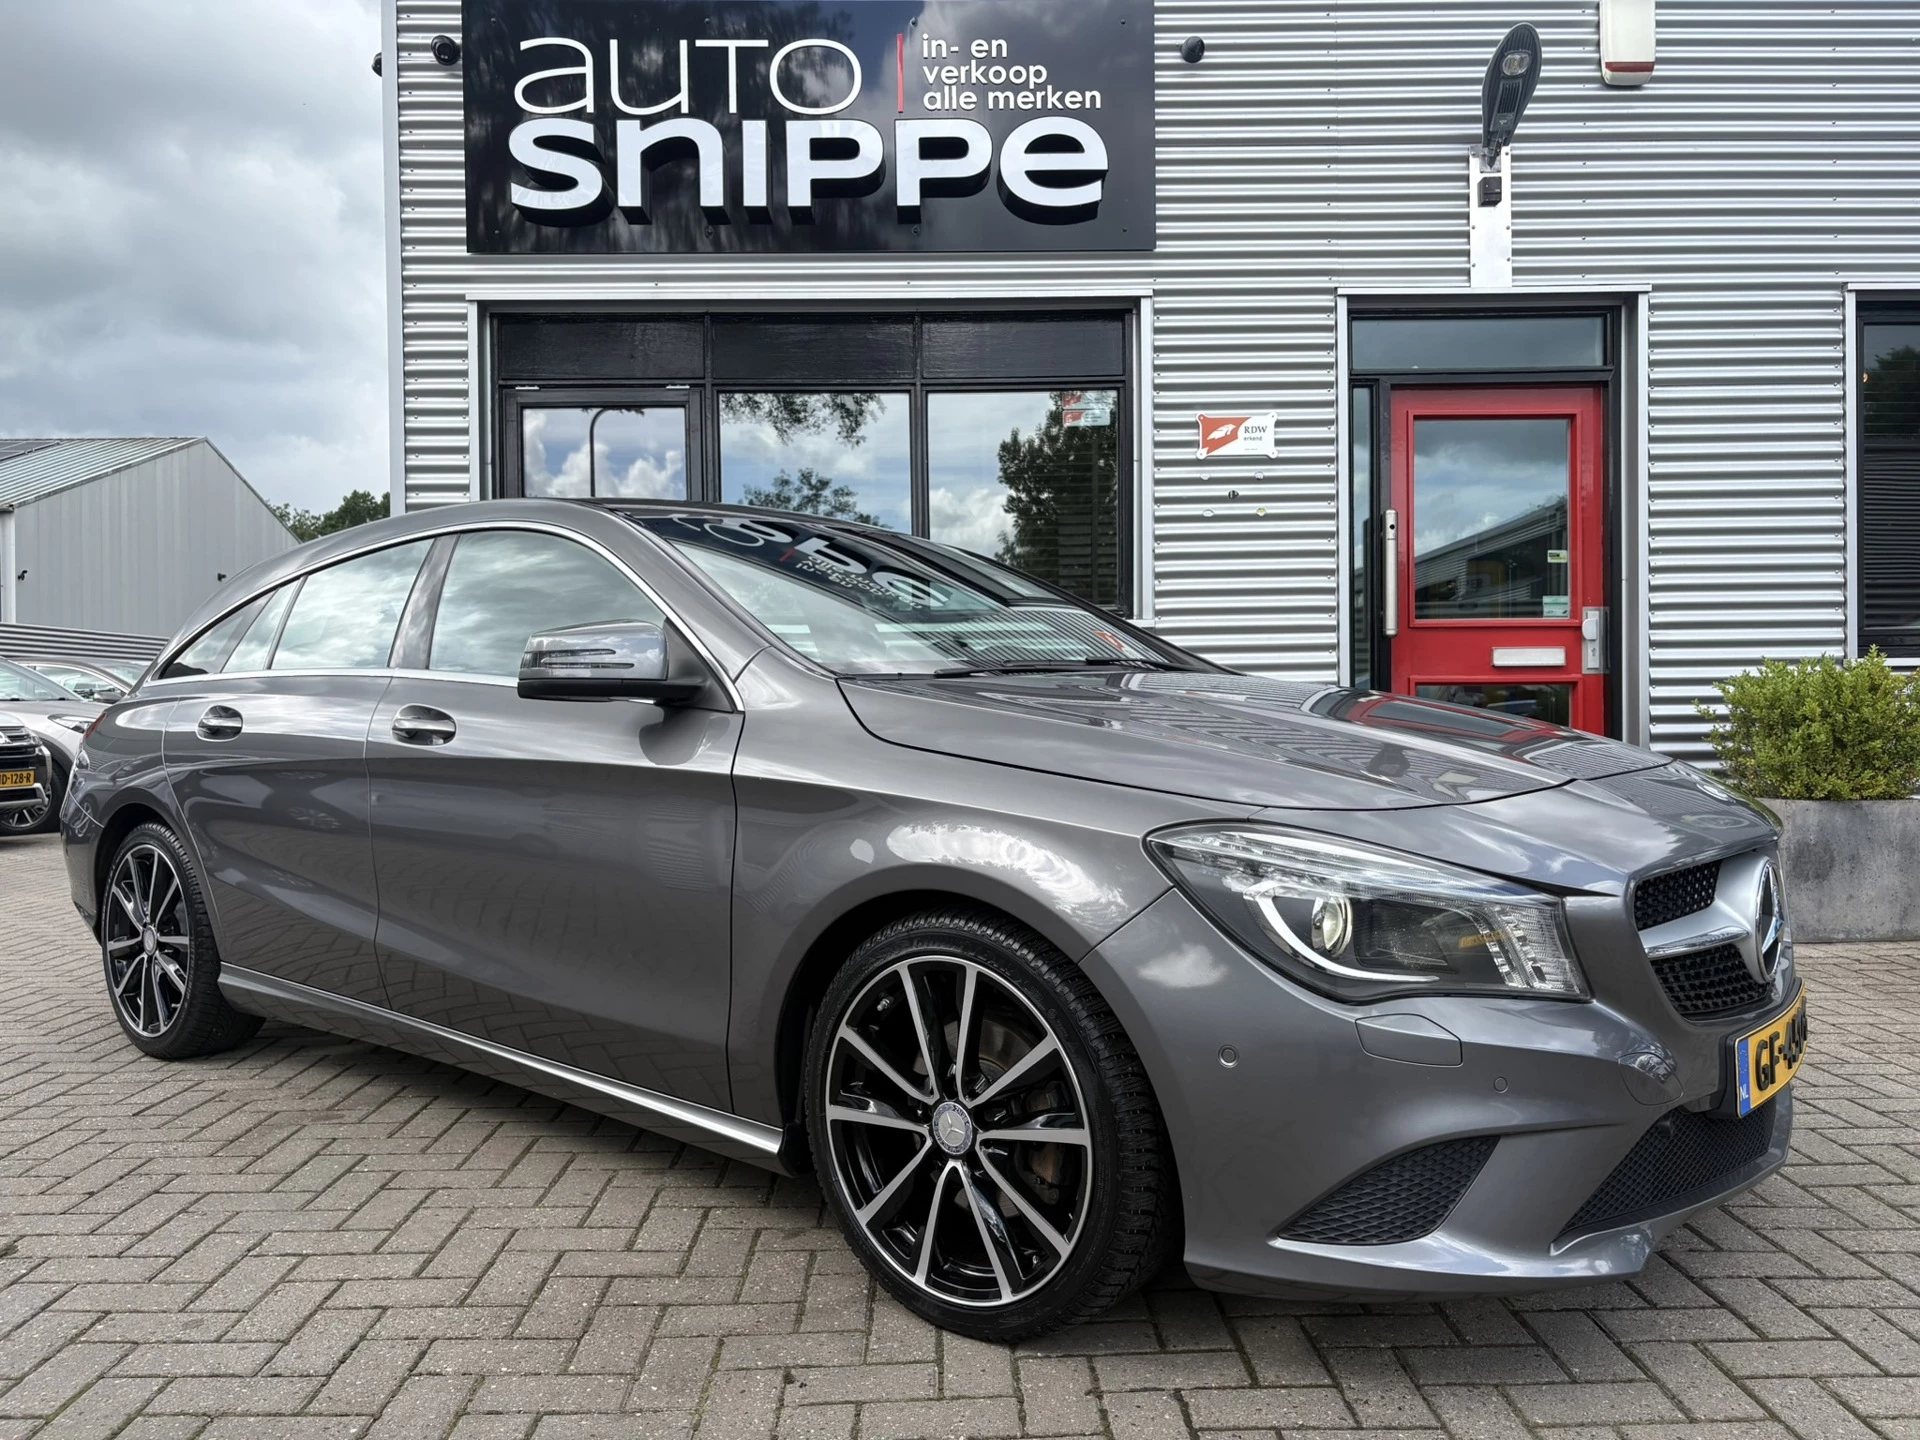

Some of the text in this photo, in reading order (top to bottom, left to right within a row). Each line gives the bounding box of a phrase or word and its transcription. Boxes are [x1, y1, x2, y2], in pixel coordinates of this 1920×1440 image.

[922, 33, 1008, 59] in- en
[922, 60, 1048, 89] verkoop
[923, 85, 1102, 111] alle merken
[1244, 425, 1268, 434] RDW
[0, 772, 32, 785] D-128-R
